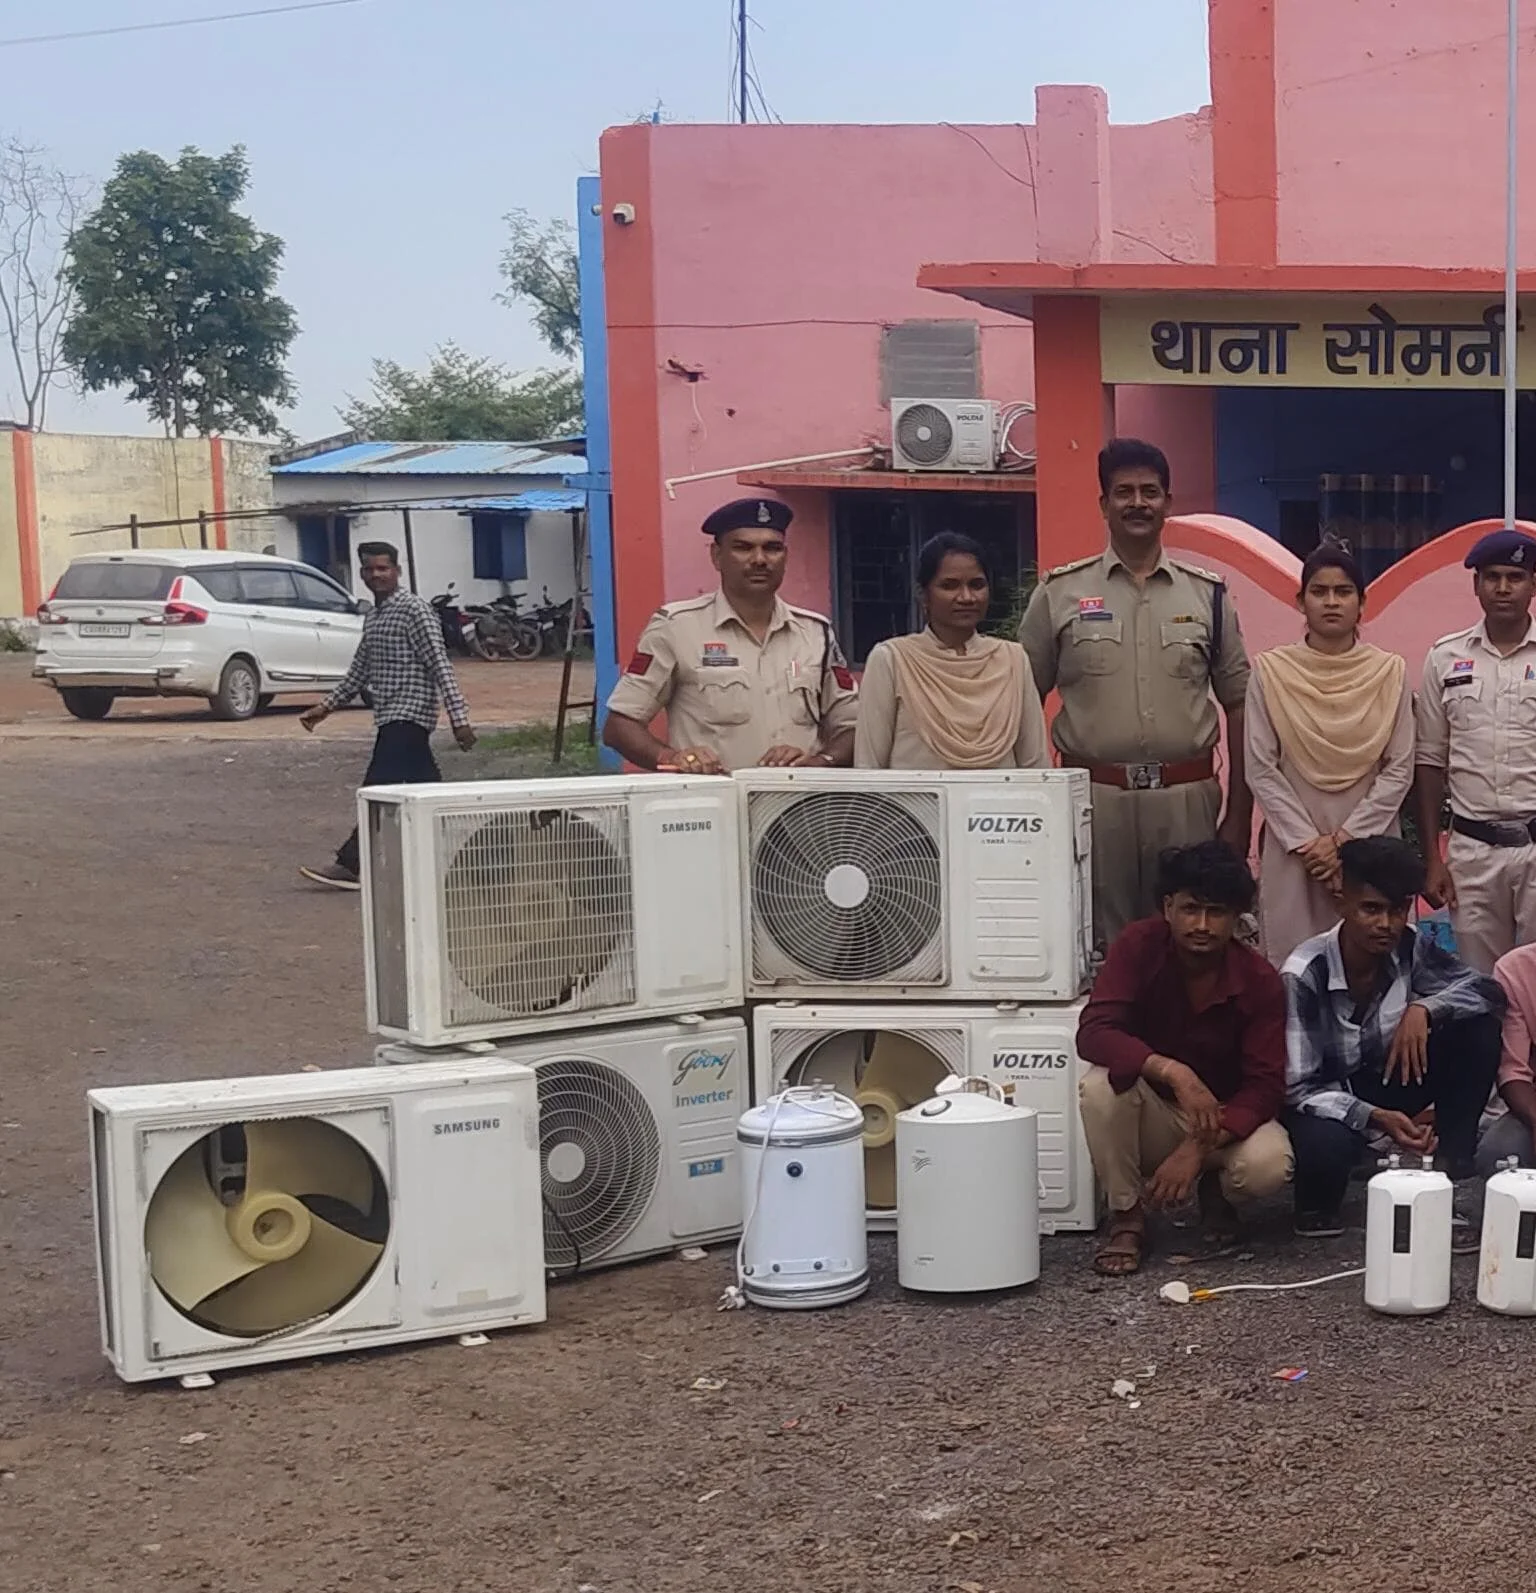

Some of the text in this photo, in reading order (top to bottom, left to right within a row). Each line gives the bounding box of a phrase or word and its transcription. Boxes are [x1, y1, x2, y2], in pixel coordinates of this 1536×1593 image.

[1151, 320, 1301, 376] थाना
[661, 820, 713, 833] SAMSUNG
[967, 817, 1044, 833] VOLTAS
[992, 1053, 1069, 1069] VOLTAS
[675, 1089, 734, 1108] Inverter
[433, 1117, 501, 1135] SAMSUNG
